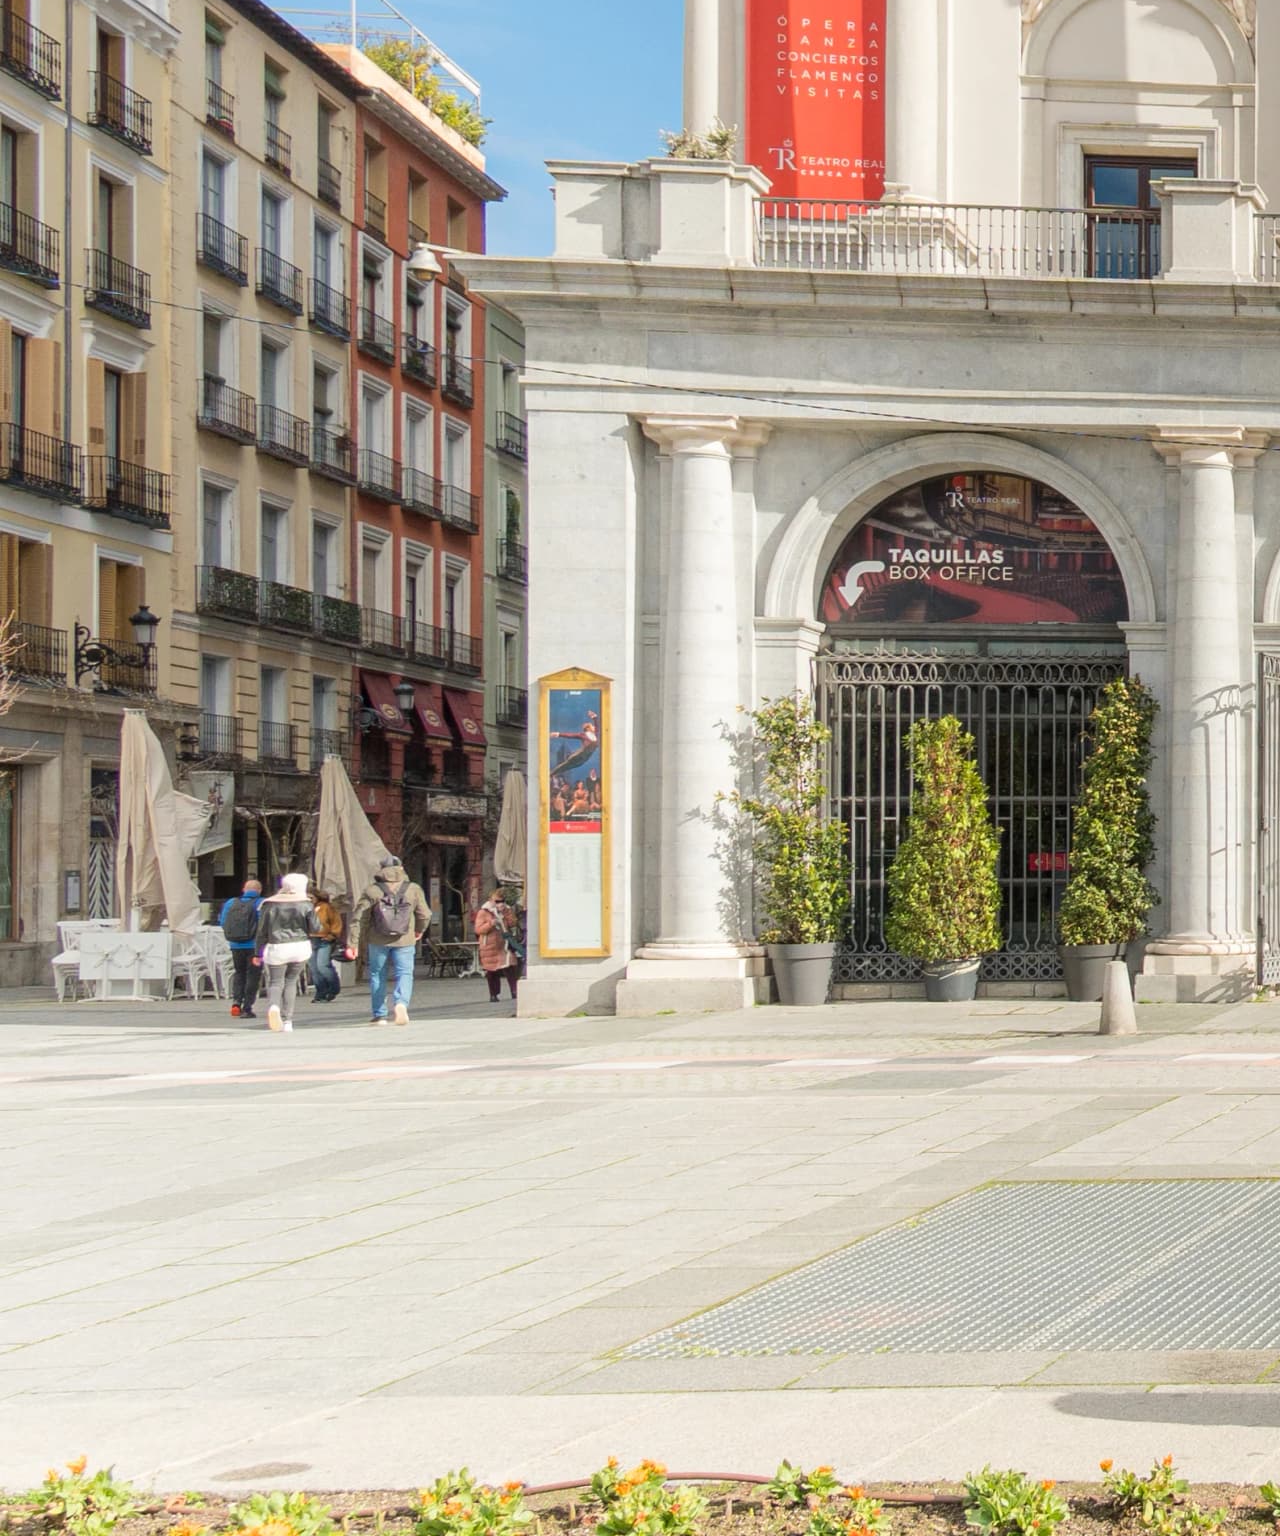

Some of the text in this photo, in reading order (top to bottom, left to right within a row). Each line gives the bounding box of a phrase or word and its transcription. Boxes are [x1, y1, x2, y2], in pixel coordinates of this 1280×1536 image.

[777, 14, 879, 32] ÓPERA
[777, 33, 879, 49] DANZA
[777, 50, 879, 66] CONCIERTOS
[777, 67, 879, 83] FLAMENCO
[776, 84, 879, 100] VISITAS
[801, 155, 886, 169] TEATRO REAL
[888, 548, 1004, 564] TAQUILLAS
[889, 565, 1014, 581] BOX OFFICE
